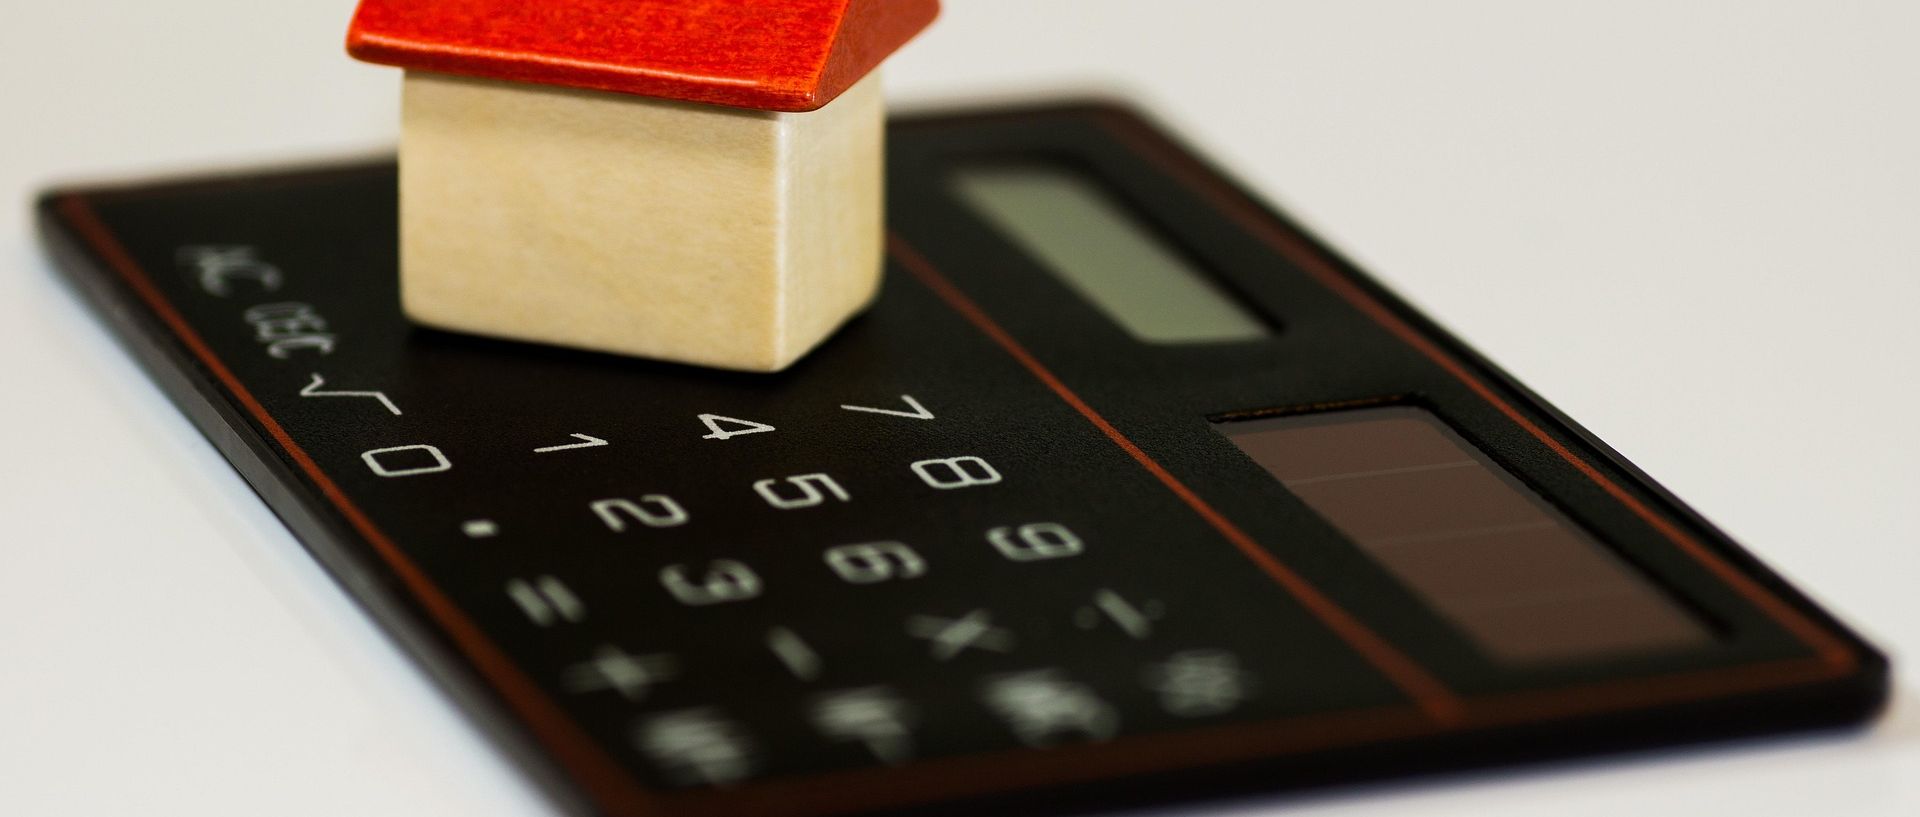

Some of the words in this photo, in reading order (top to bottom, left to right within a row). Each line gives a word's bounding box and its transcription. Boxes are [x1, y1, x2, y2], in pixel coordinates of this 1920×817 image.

[360, 443, 452, 477] 0
[533, 432, 609, 453] 1
[591, 495, 688, 530] 2
[658, 560, 757, 605] 3
[697, 413, 776, 441] 4
[753, 473, 849, 510] 5
[827, 543, 925, 581] 6
[841, 394, 936, 420] 7
[910, 455, 1002, 489] 8
[987, 523, 1082, 560] 9
